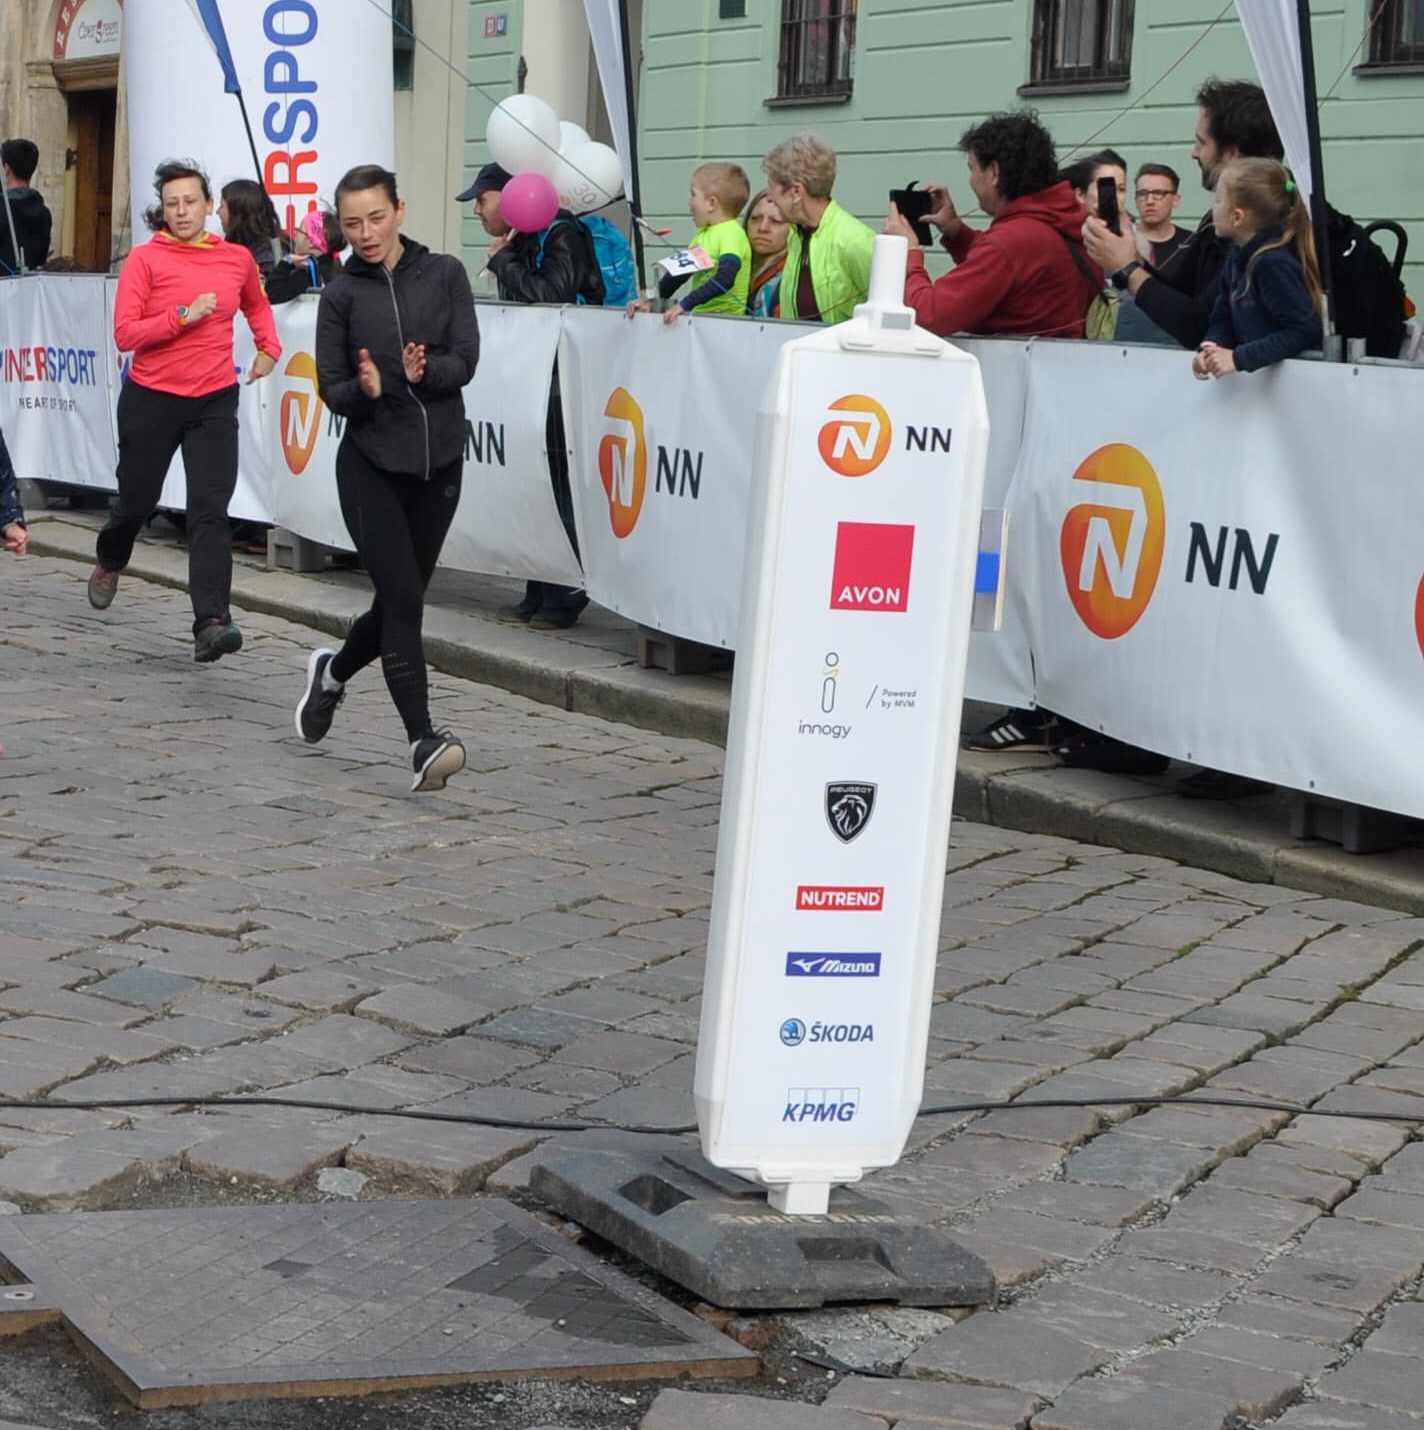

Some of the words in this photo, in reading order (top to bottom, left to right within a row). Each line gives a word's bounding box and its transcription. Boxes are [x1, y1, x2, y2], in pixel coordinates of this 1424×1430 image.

[905, 425, 953, 454] NN
[655, 445, 704, 501] NN
[1184, 521, 1280, 596] NN
[838, 585, 901, 605] AVON
[894, 699, 916, 708] MVM
[798, 719, 852, 739] innogy
[800, 890, 880, 906] NUTREND
[809, 1021, 874, 1043] ŠKODA
[782, 1100, 856, 1123] KPMG
